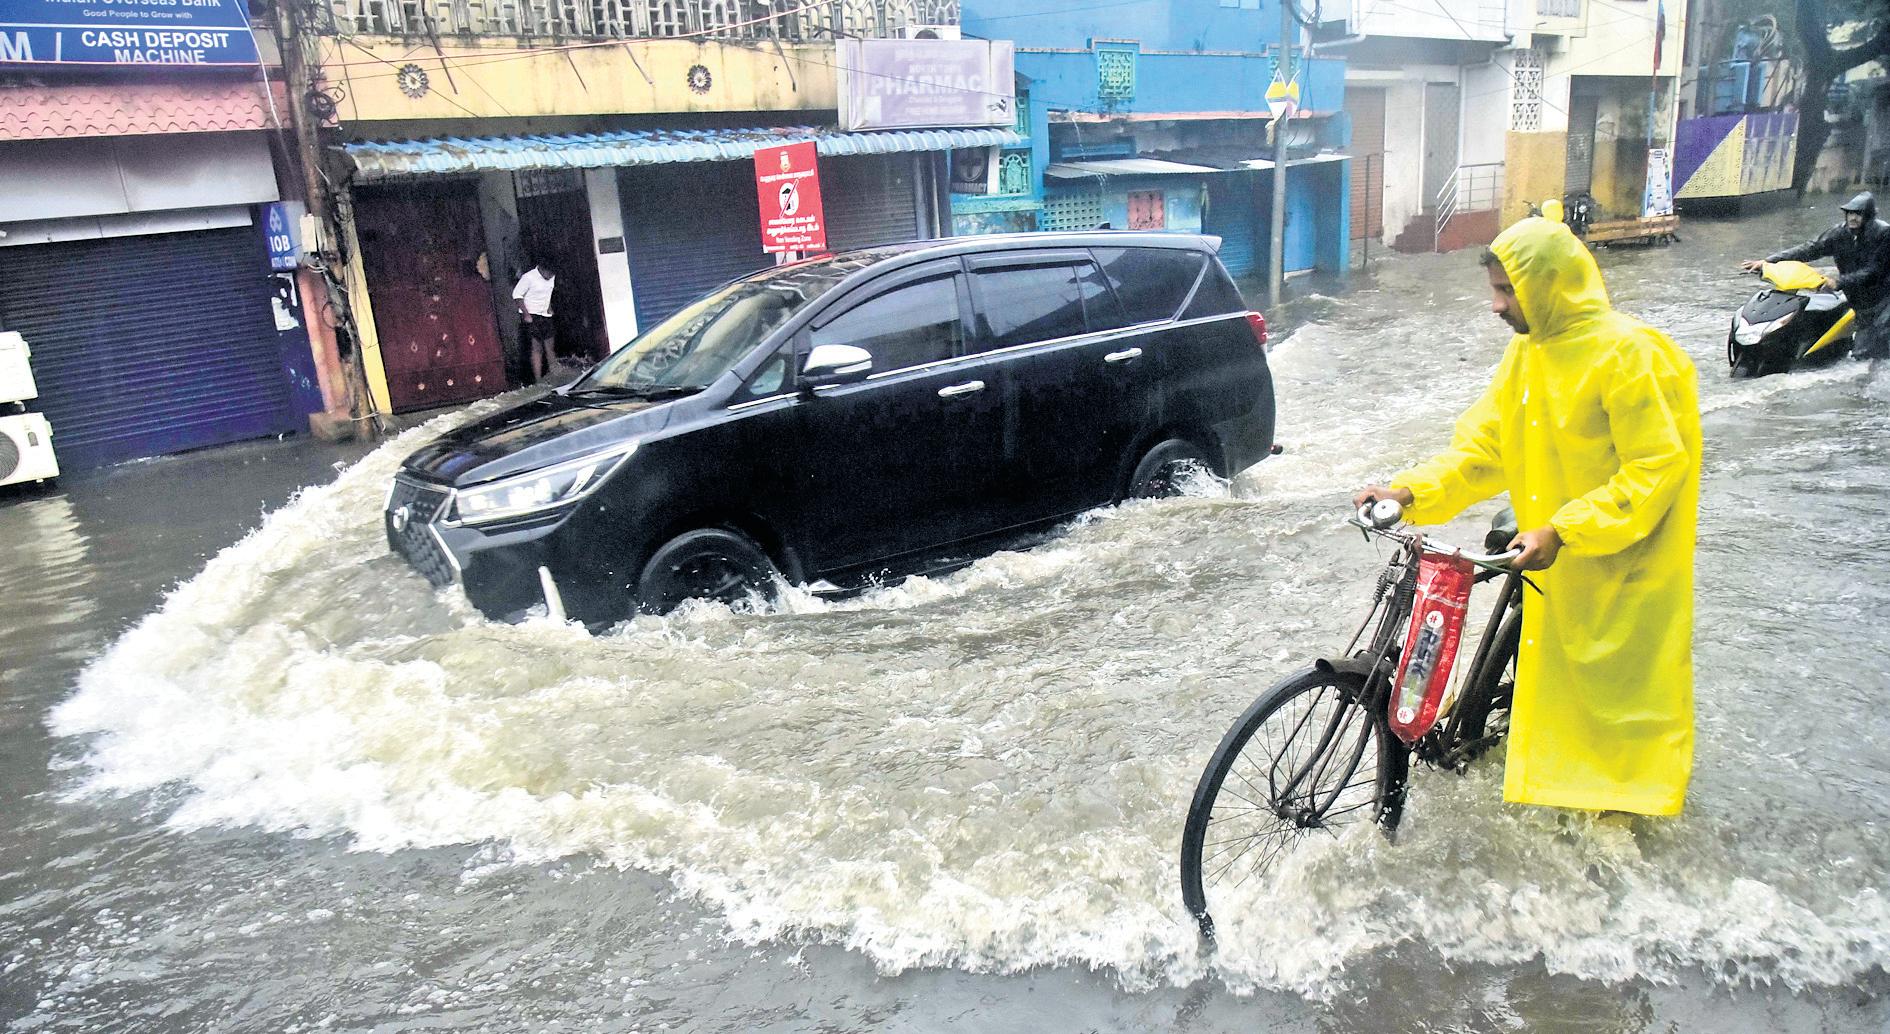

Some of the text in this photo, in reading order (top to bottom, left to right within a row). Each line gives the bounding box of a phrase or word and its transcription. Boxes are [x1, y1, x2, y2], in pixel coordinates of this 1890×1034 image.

[83, 9, 107, 17] Good
[108, 10, 139, 18] People
[81, 31, 230, 48] CASH DEPOSIT
[114, 49, 207, 63] MACHINE
[870, 74, 984, 96] PHARMAC
[270, 235, 290, 252] IOB
